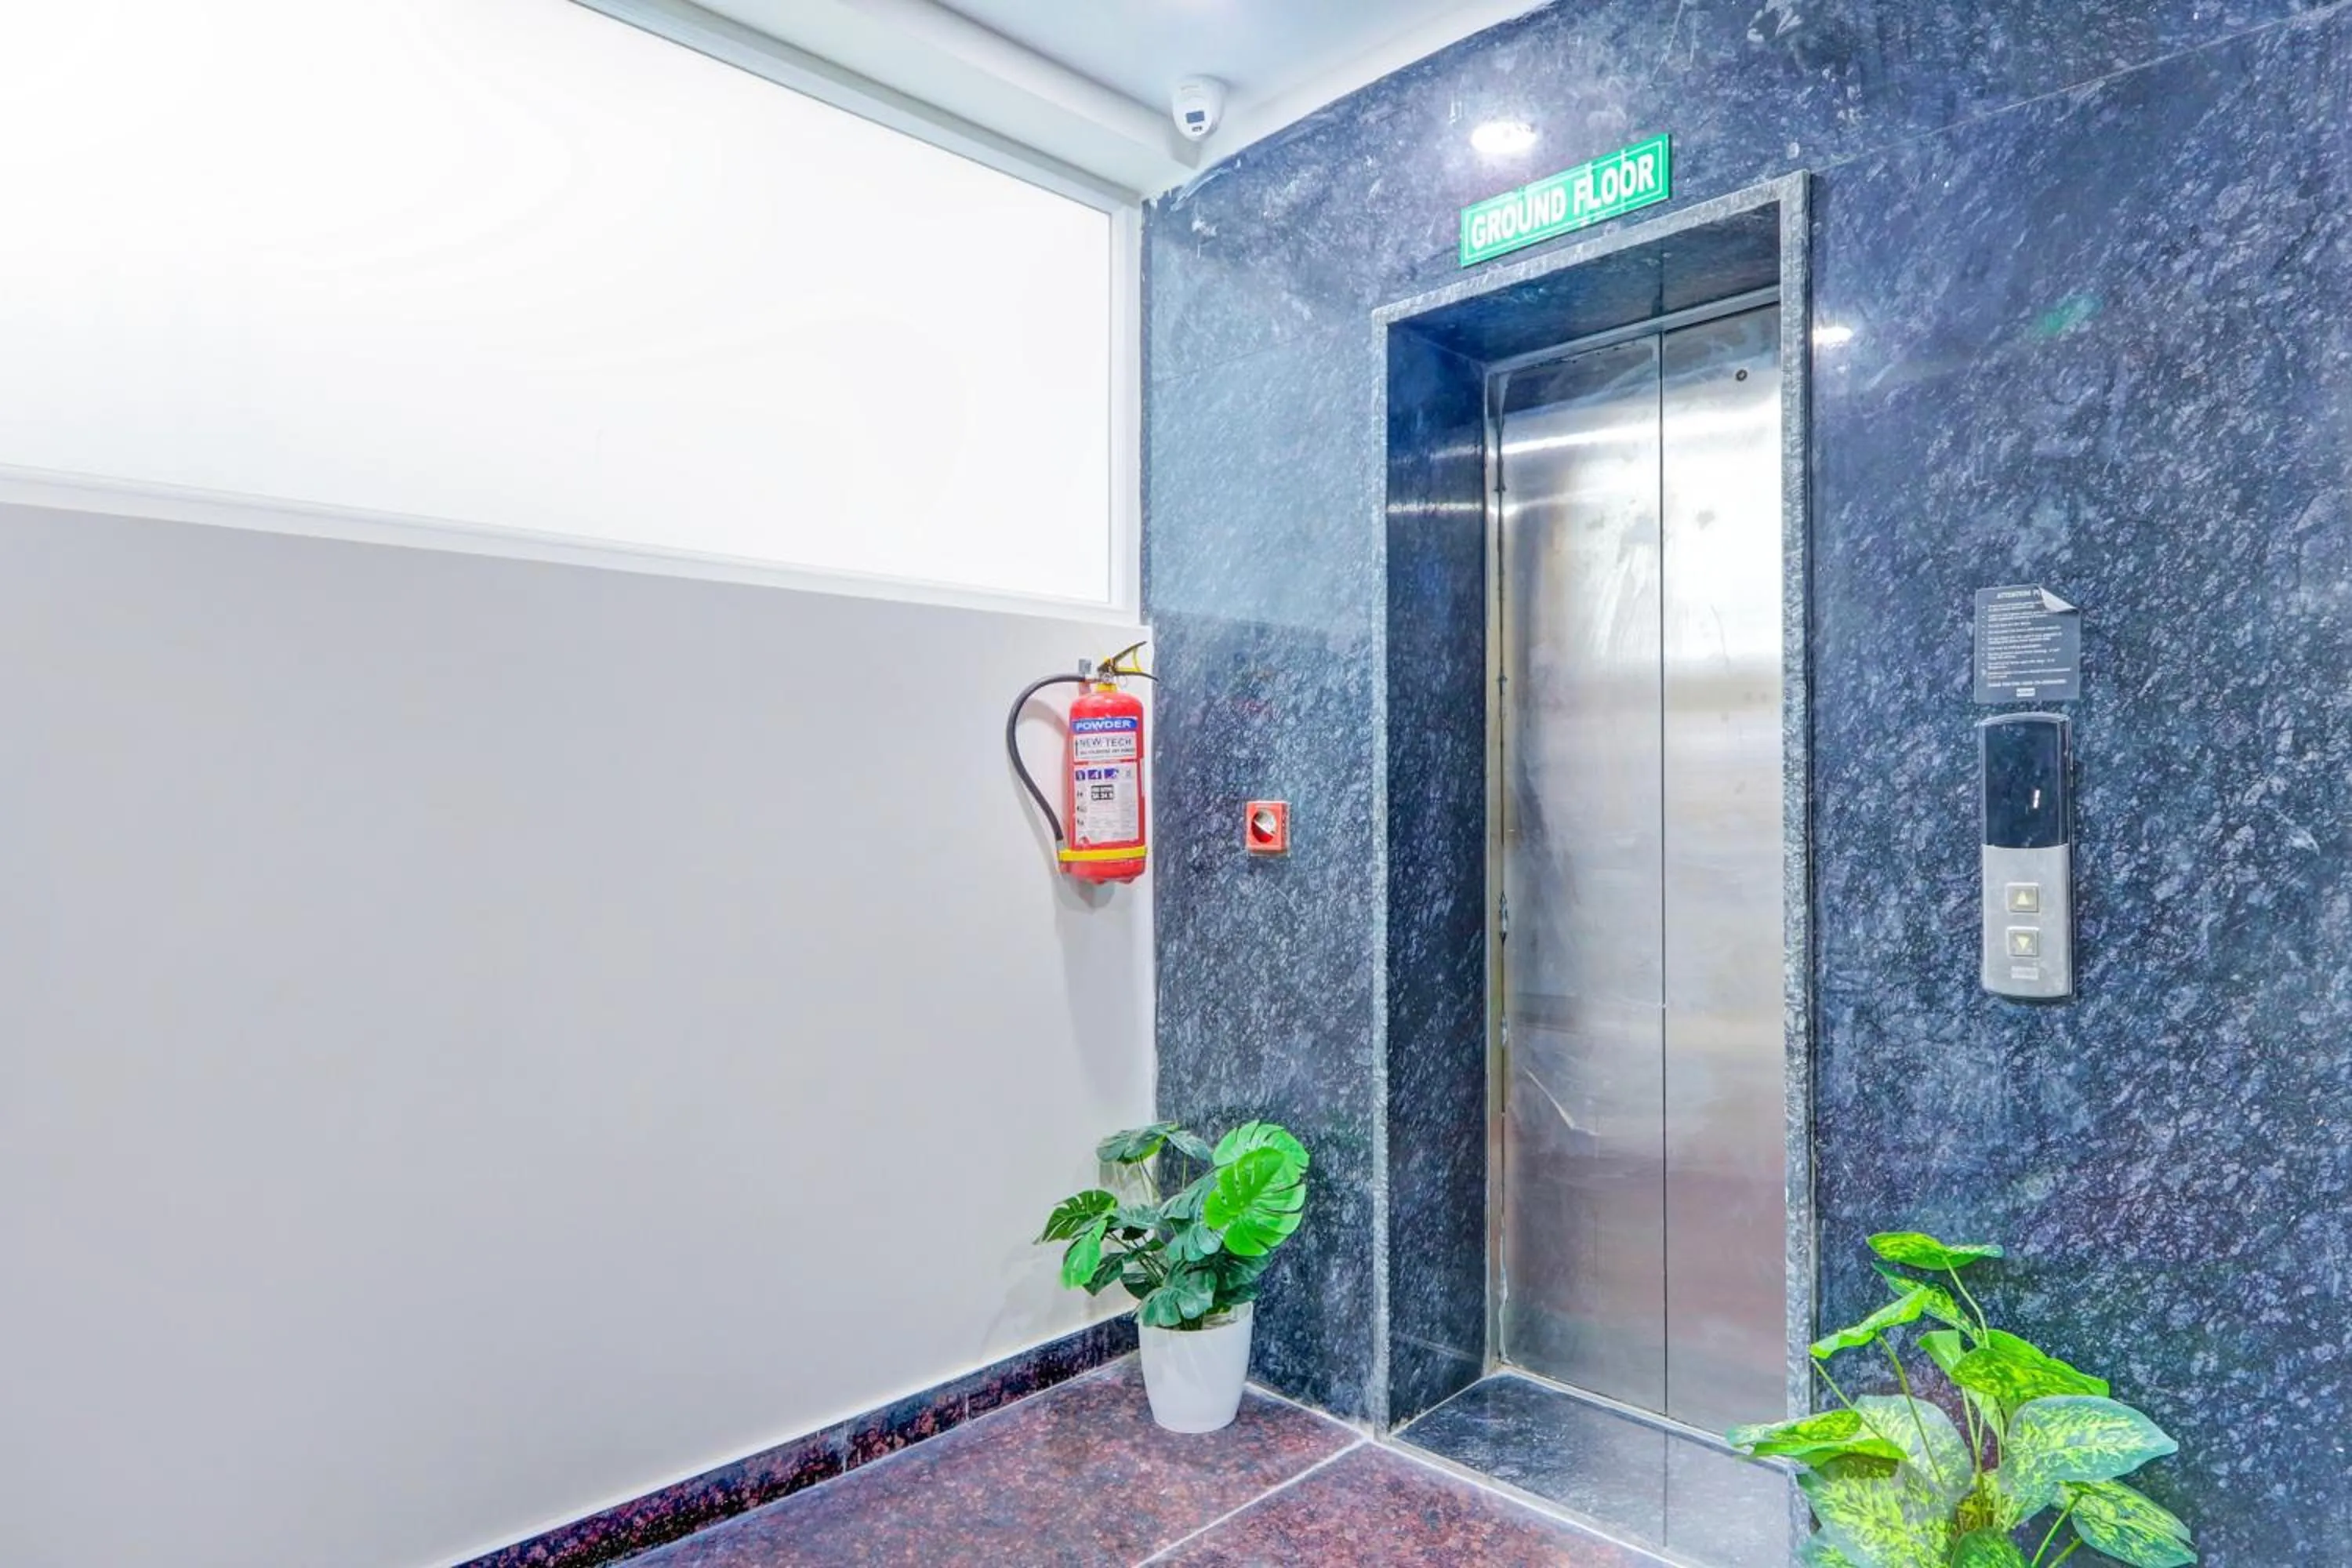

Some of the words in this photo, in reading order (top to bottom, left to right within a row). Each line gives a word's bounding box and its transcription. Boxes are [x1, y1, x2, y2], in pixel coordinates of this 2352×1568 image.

[1471, 187, 1566, 250] GROUND
[1573, 154, 1656, 215] FLOOR
[1076, 720, 1131, 731] POWDER
[1104, 737, 1132, 747] TECH
